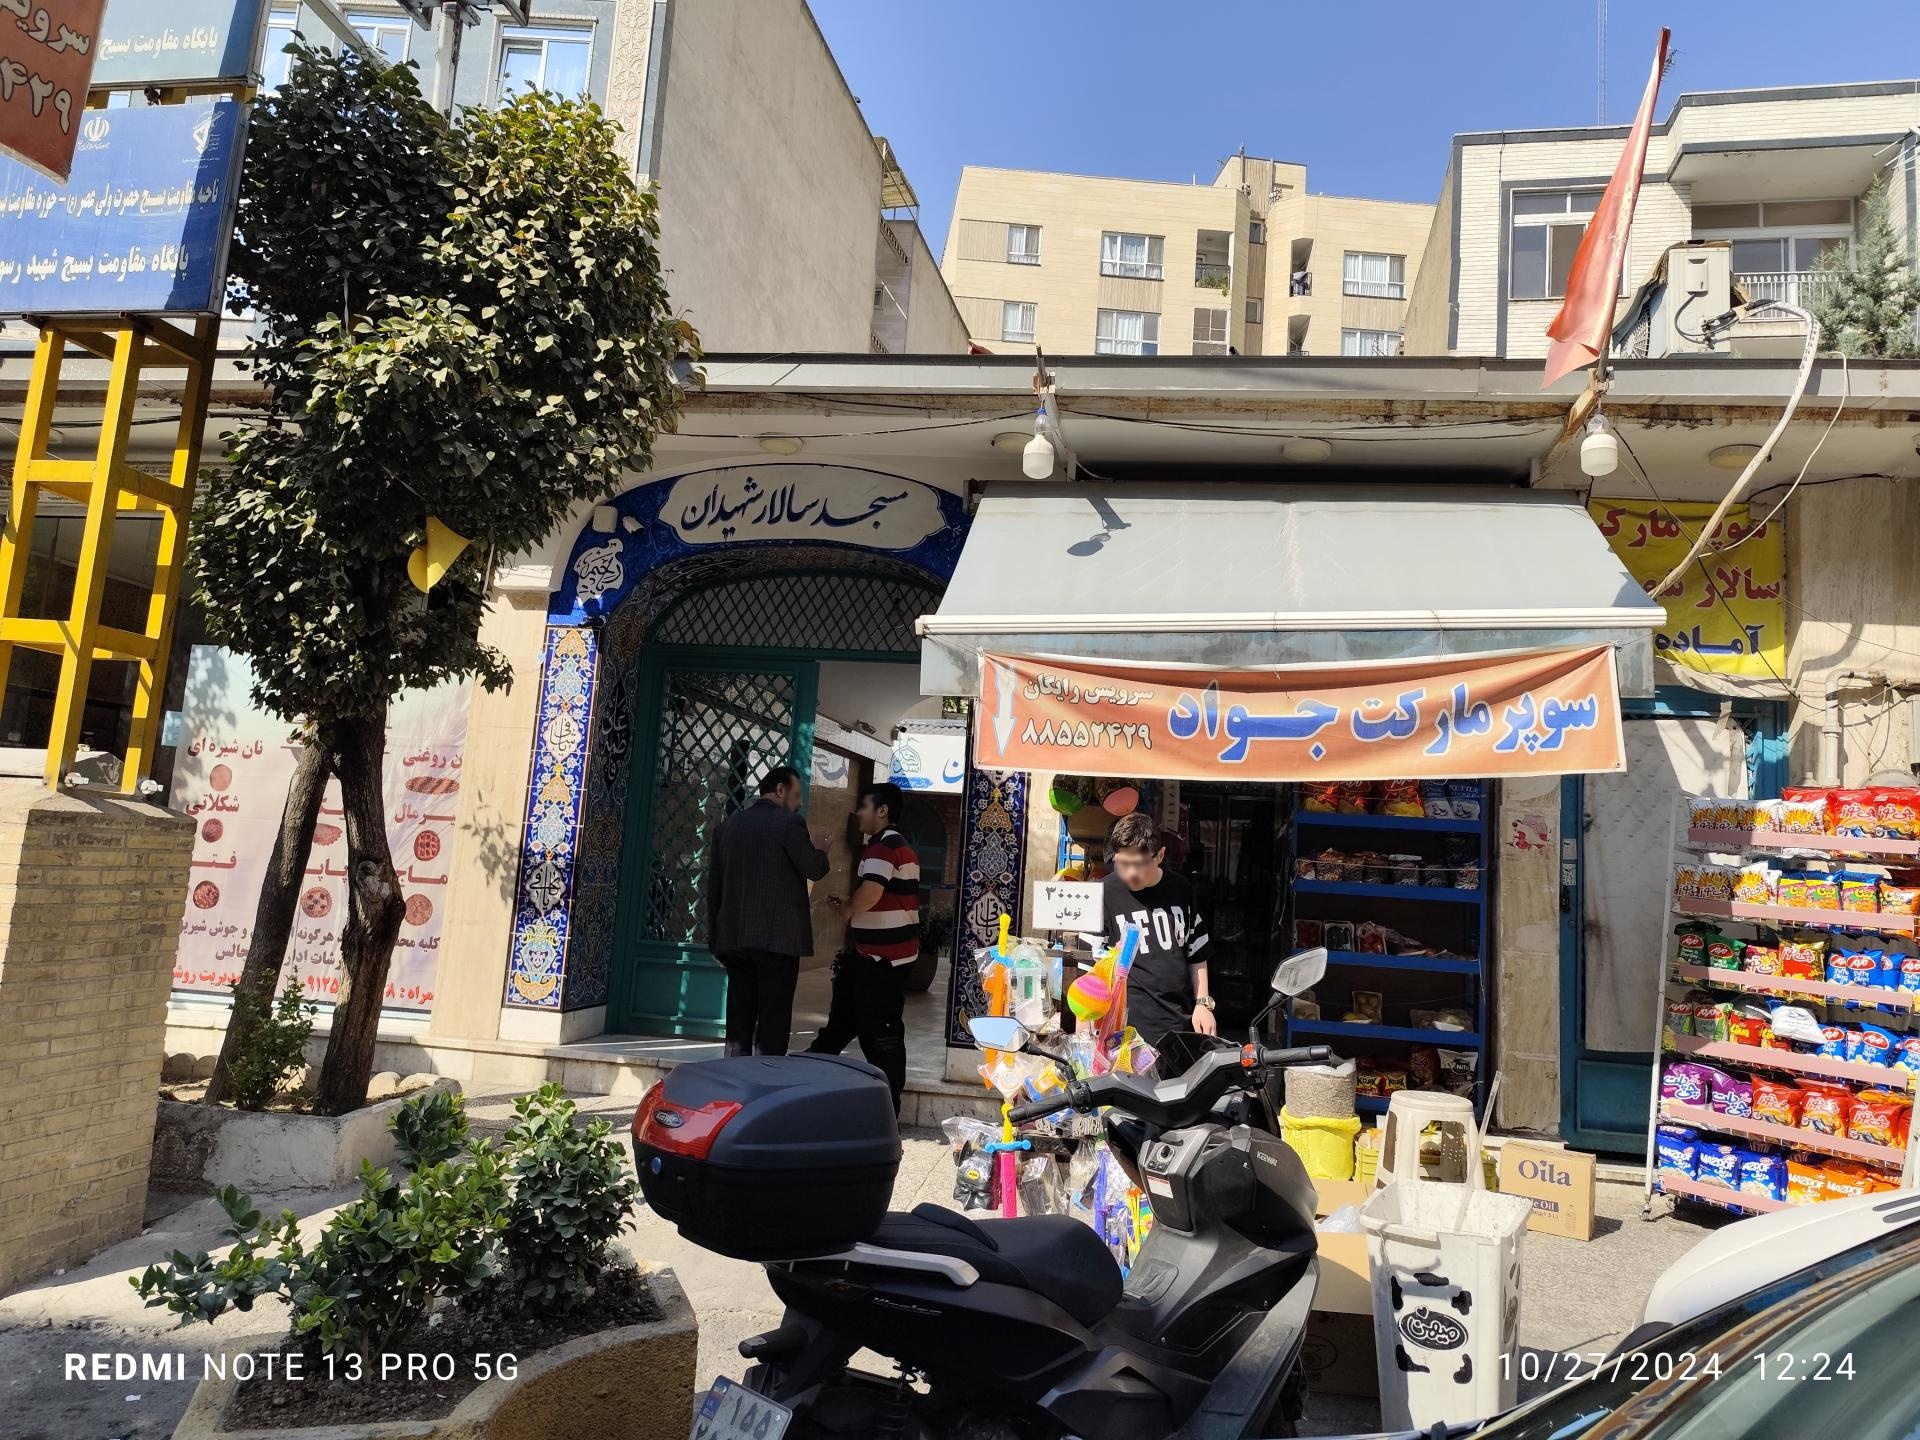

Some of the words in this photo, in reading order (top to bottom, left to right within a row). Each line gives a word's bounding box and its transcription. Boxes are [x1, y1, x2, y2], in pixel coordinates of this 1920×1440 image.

[99, 37, 131, 61] بسیج
[133, 27, 179, 59] مقاومت
[182, 24, 218, 56] پایگاه
[26, 248, 58, 282] شهید
[60, 254, 94, 282] بسیج
[98, 245, 146, 282] مقاومت
[151, 244, 189, 281] پایگاه
[681, 477, 764, 537] شهیدان
[751, 483, 819, 525] سالار
[809, 491, 908, 530] مسجد
[1599, 508, 1680, 547] مارک
[1695, 567, 1781, 608] سالار
[1654, 624, 1765, 655] آماده
[1023, 673, 1080, 704] رایگان
[1084, 685, 1154, 706] سرویس
[1021, 718, 1153, 750] ۸۸۵۵۲۴۲۹
[1167, 679, 1340, 763] جواد
[1493, 691, 1599, 755] سوپر
[242, 740, 263, 759] نان
[403, 747, 447, 768] روغنی
[185, 793, 239, 816] شکلاتی
[395, 803, 456, 826] یرمال
[182, 920, 207, 935] شیری
[1055, 907, 1081, 921] تومان
[209, 921, 238, 938] جوش
[215, 943, 248, 960] جالس
[419, 937, 440, 953] کلیه
[173, 966, 196, 983] روش
[407, 985, 434, 1005] مراه
[1518, 1160, 1571, 1187] Oila
[1540, 1200, 1555, 1211] Oil
[1407, 1315, 1460, 1345] میهن
